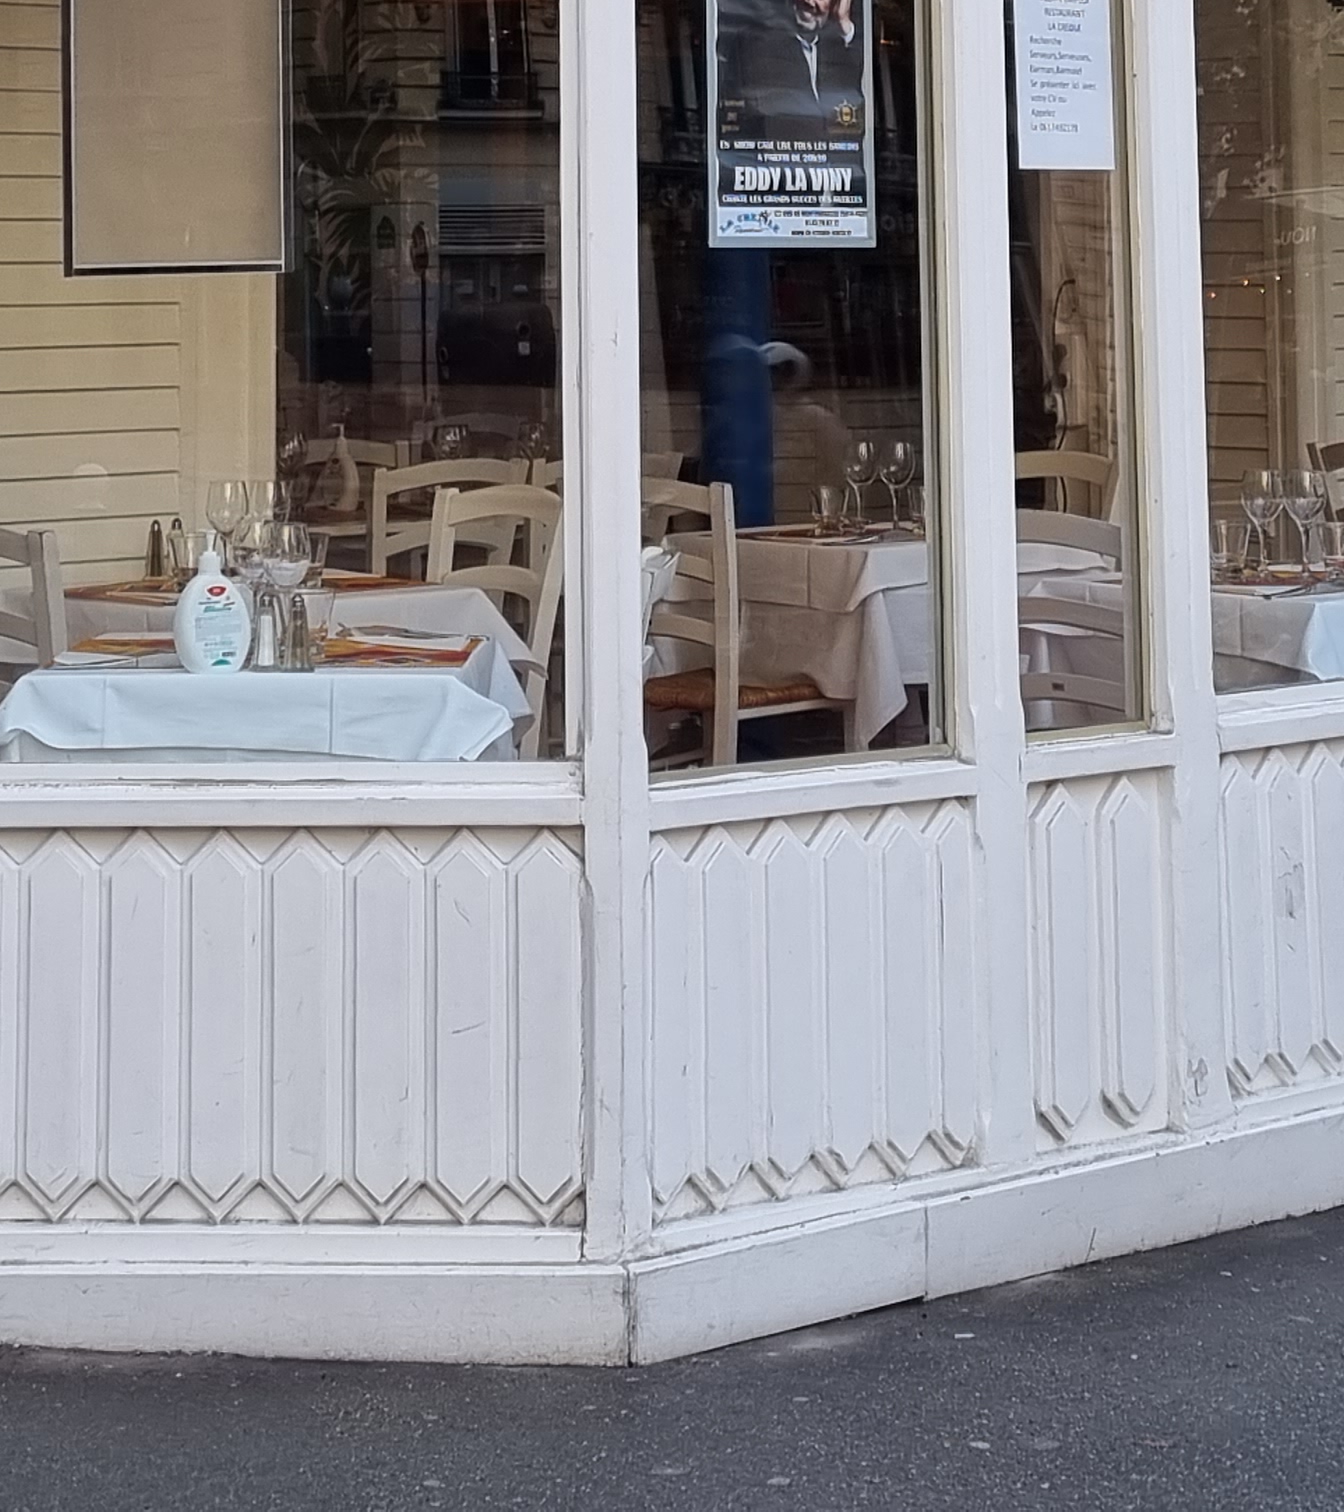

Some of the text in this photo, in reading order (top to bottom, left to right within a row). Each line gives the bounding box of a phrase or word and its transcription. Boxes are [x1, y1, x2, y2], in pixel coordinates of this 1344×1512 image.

[734, 166, 852, 192] EDDY LA VINY
